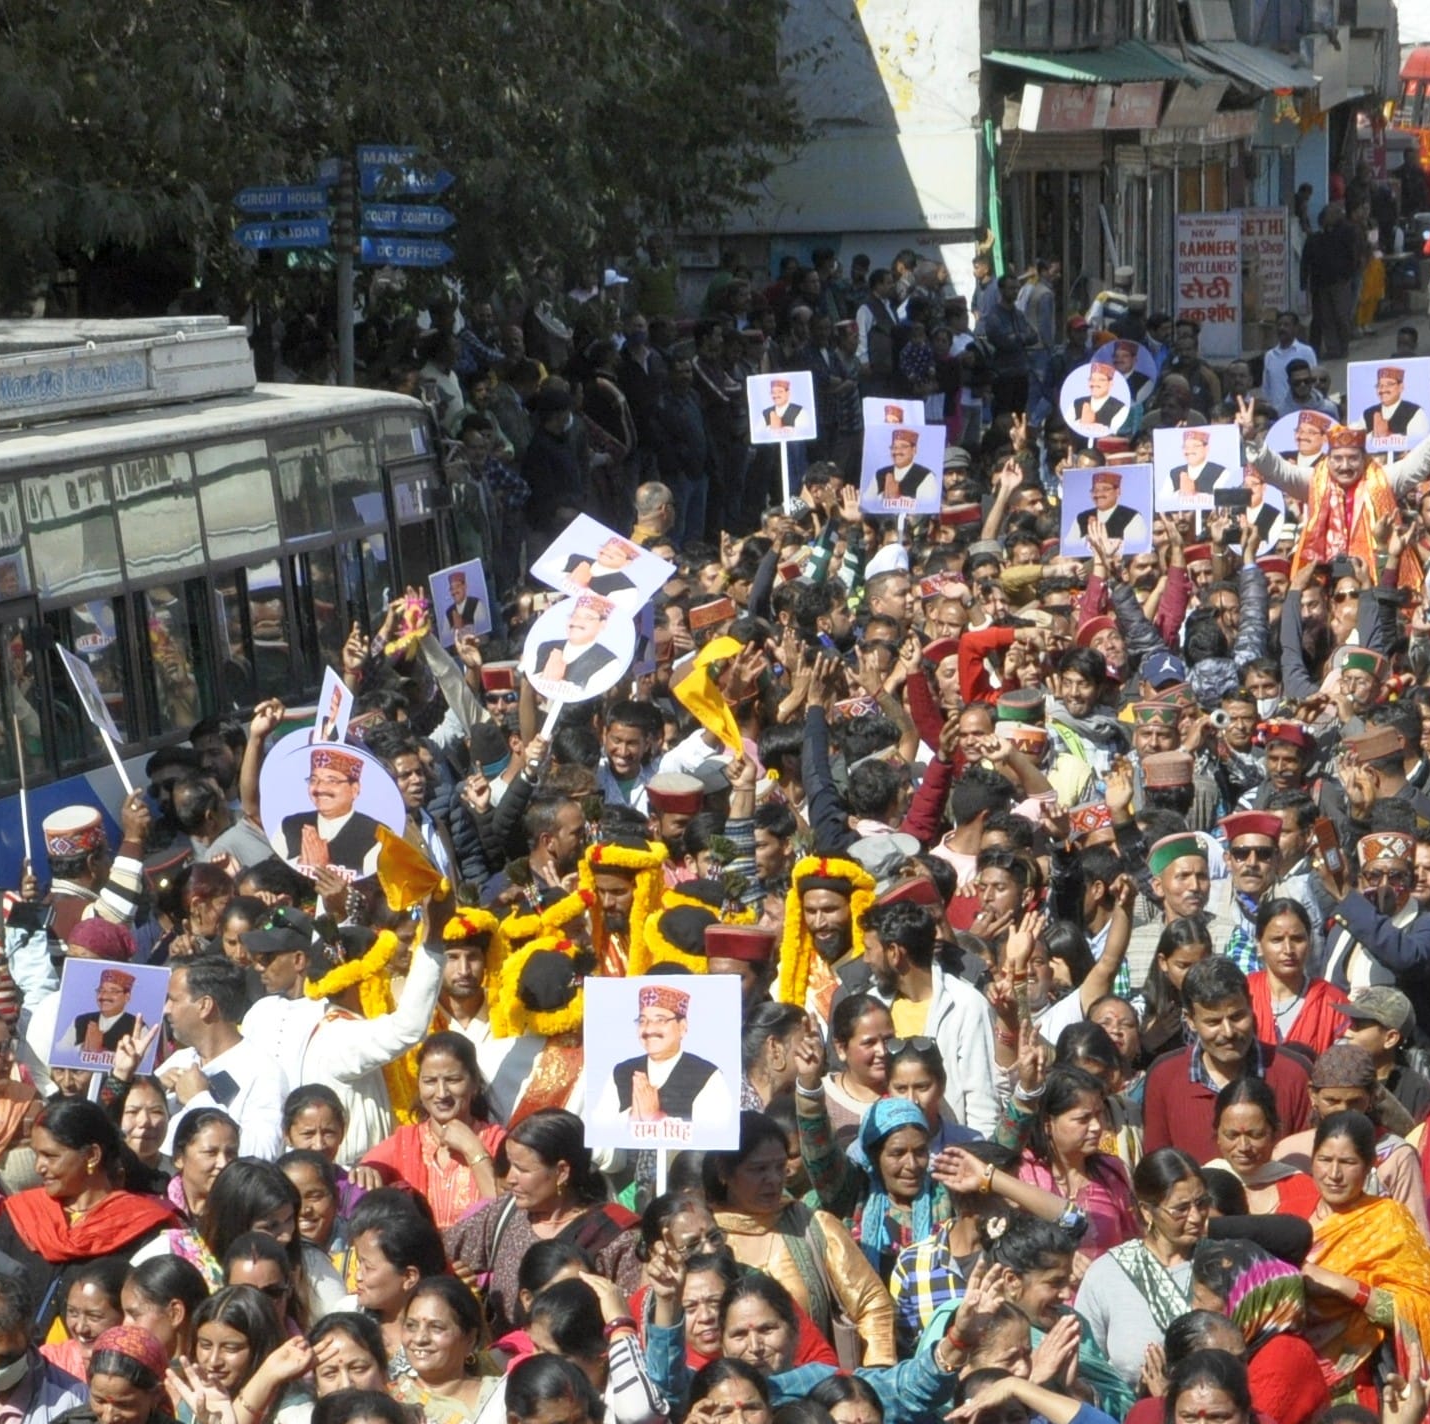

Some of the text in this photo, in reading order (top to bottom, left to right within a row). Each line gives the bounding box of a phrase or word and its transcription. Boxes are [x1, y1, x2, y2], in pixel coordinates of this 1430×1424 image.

[240, 191, 322, 206] CIRCUIT HOUSE
[365, 210, 445, 225] COURT COMPLEX
[1191, 229, 1217, 238] NEW
[377, 245, 442, 259] DC OFFICE
[1179, 241, 1237, 257] RAMNEEK
[1179, 261, 1237, 274] DRYCLEANERS
[1180, 275, 1232, 299] सेठी
[82, 1053, 99, 1063] राम
[634, 1120, 691, 1141] राम सिंह
